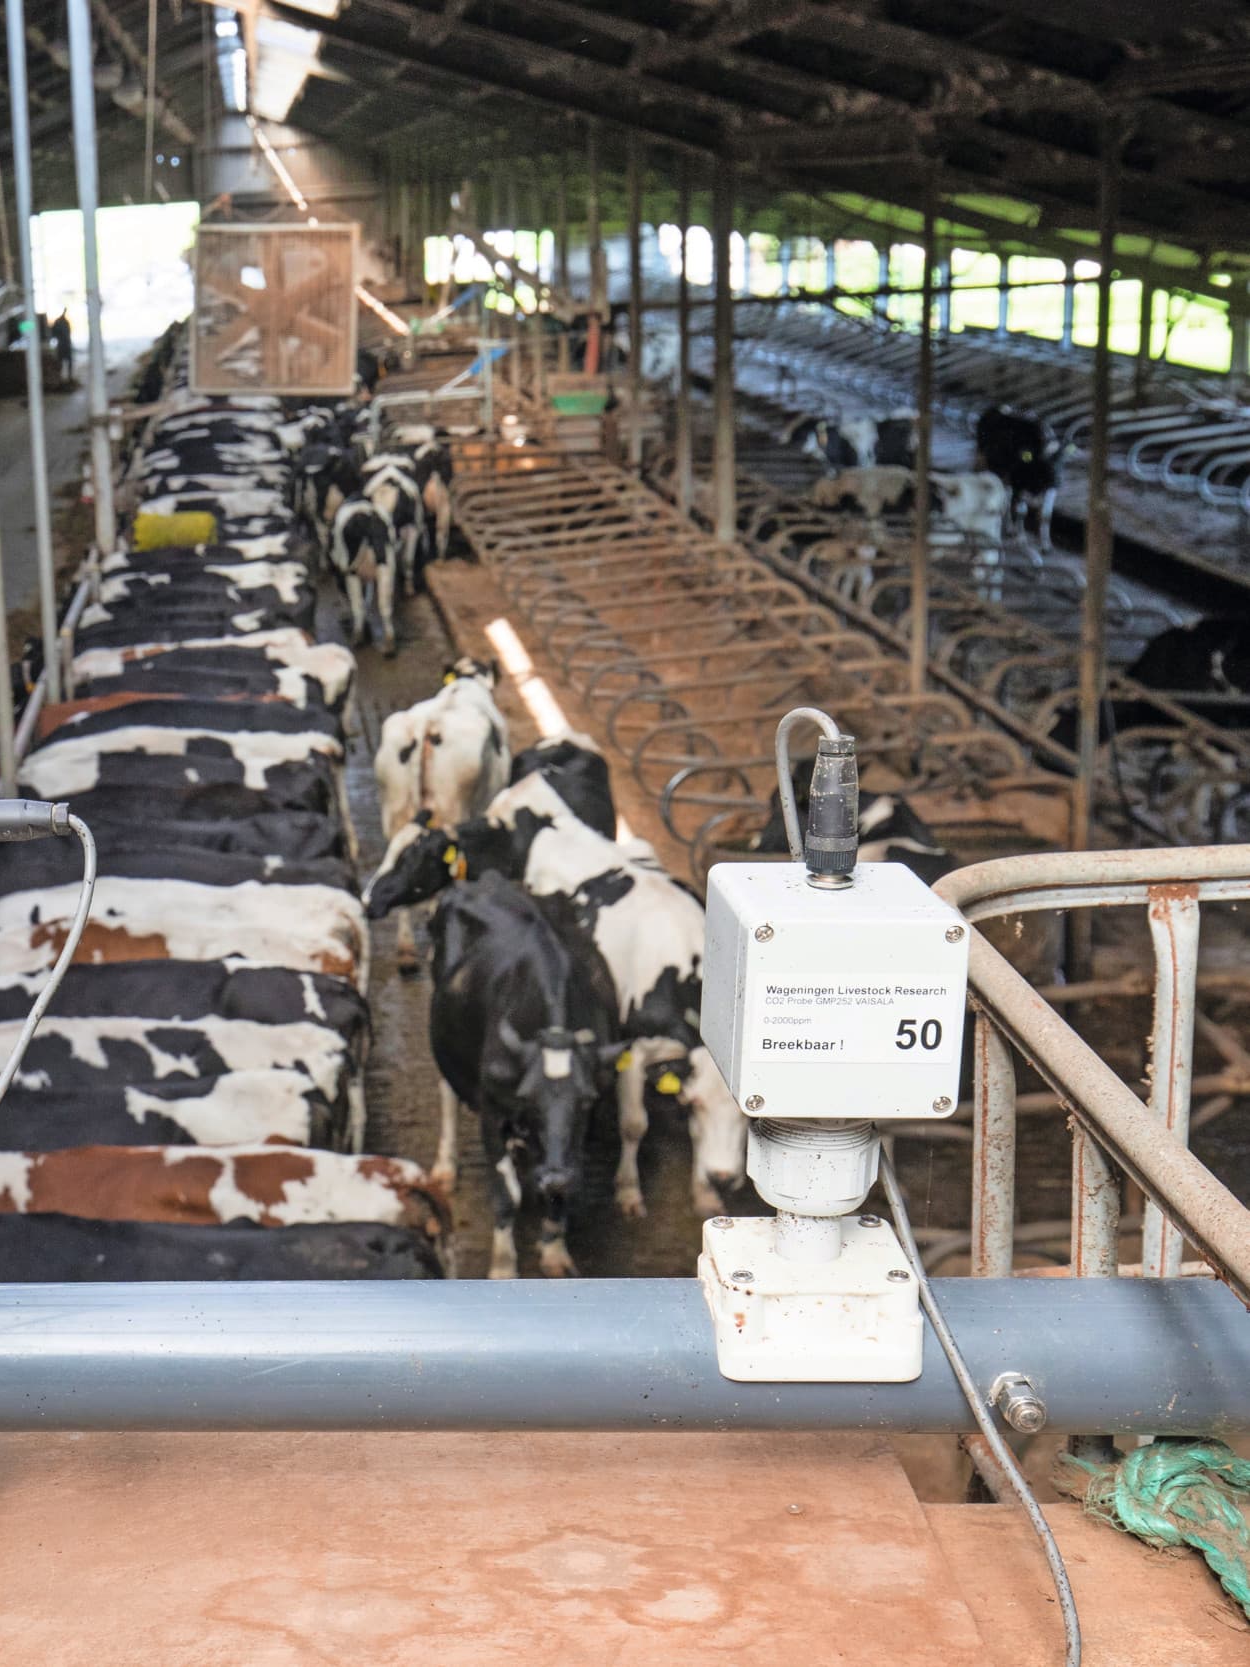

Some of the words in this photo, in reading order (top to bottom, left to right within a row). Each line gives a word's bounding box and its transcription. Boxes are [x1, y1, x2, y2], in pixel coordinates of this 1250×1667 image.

[766, 985, 835, 996] Wageningen
[837, 985, 891, 995] Livestock
[894, 986, 947, 995] Research
[765, 997, 785, 1005] CO2
[787, 997, 813, 1005] Probe
[815, 997, 853, 1005] GMP252
[855, 997, 895, 1006] VAISALA
[763, 1016, 812, 1025] 0-2000ppm
[895, 1018, 943, 1051] 50
[762, 1038, 836, 1050] Breekbaar
